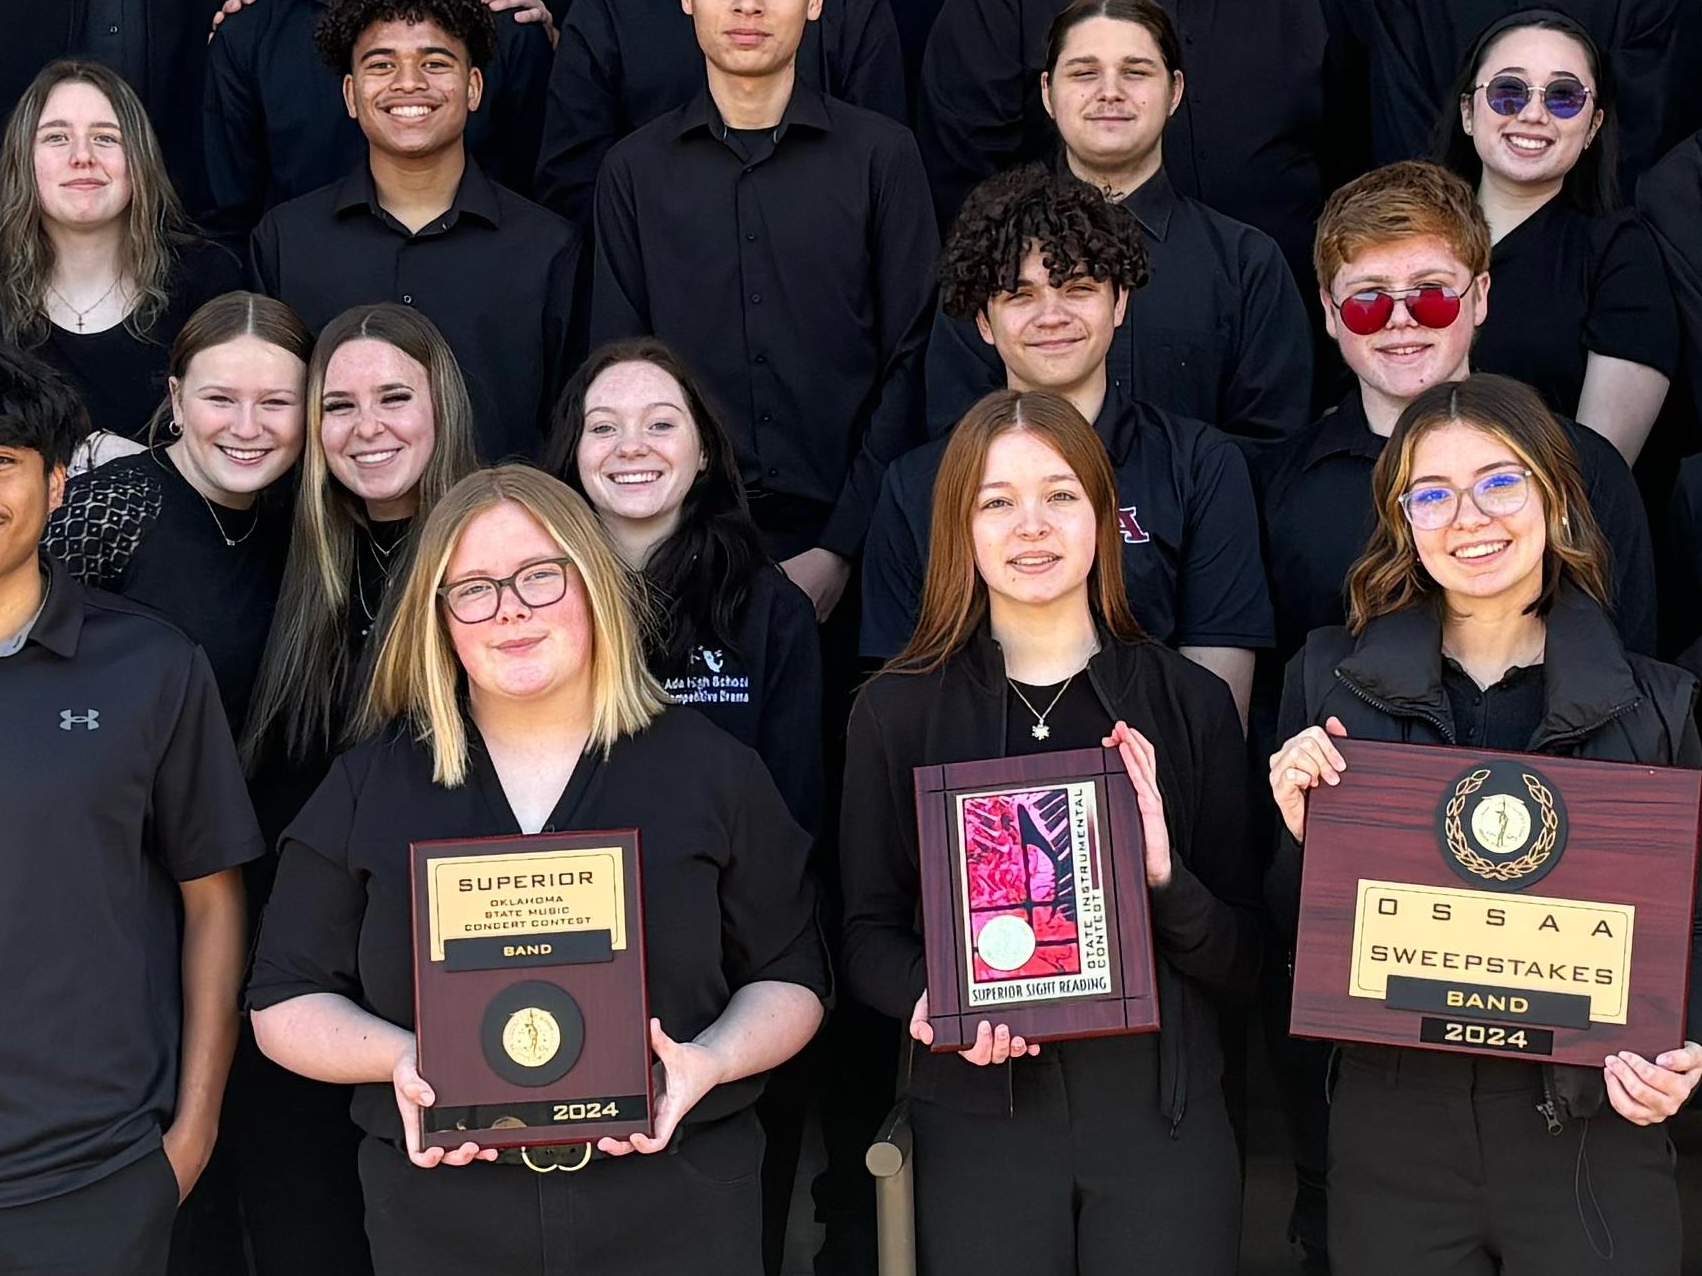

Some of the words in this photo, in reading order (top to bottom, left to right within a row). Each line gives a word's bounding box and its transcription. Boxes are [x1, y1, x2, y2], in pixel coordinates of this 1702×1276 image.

[687, 676, 710, 691] High
[712, 675, 749, 688] School
[669, 690, 718, 705] ompetitive
[1074, 787, 1094, 917] INSTRUMENTAL
[458, 871, 594, 892] SUPERIOR
[490, 895, 564, 907] OKLAHOMA
[484, 908, 523, 919] STATE
[528, 906, 570, 917] MUSIC
[464, 920, 527, 932] CONCERT
[531, 916, 592, 928] CONTEST
[503, 943, 552, 957] BAND
[1370, 945, 1614, 986] SWEEPSTAKES
[972, 984, 1023, 1002] SUPERIOR
[1026, 980, 1056, 997] SIGHT
[1059, 976, 1107, 994] READING
[1446, 990, 1530, 1014] BAND
[1444, 1024, 1529, 1049] 2024
[553, 1101, 620, 1121] 2024
